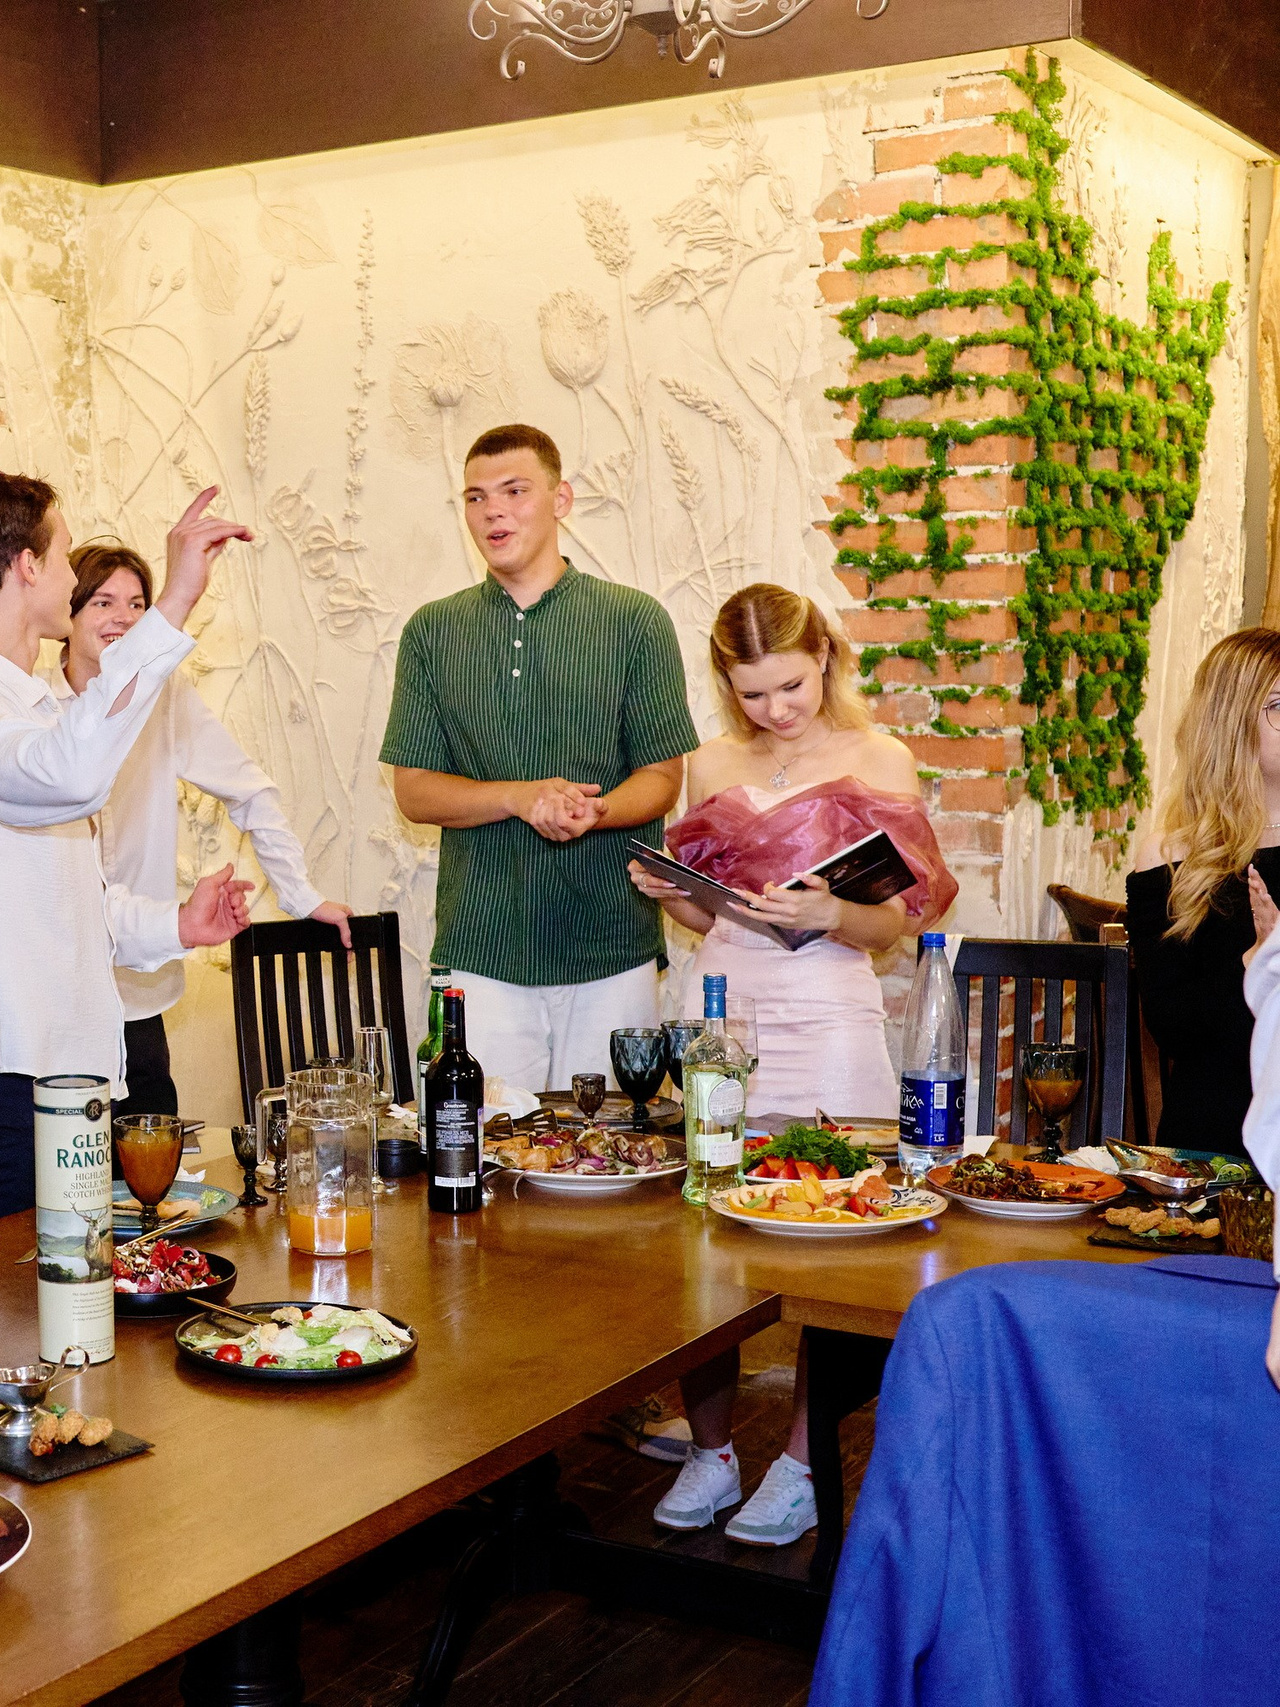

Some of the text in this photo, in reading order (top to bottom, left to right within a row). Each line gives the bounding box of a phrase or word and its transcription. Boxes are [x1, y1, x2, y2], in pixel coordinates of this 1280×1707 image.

[72, 1130, 110, 1149] GLEN
[70, 1179, 99, 1190] SINGLE
[63, 1189, 95, 1199] SCOTCH
